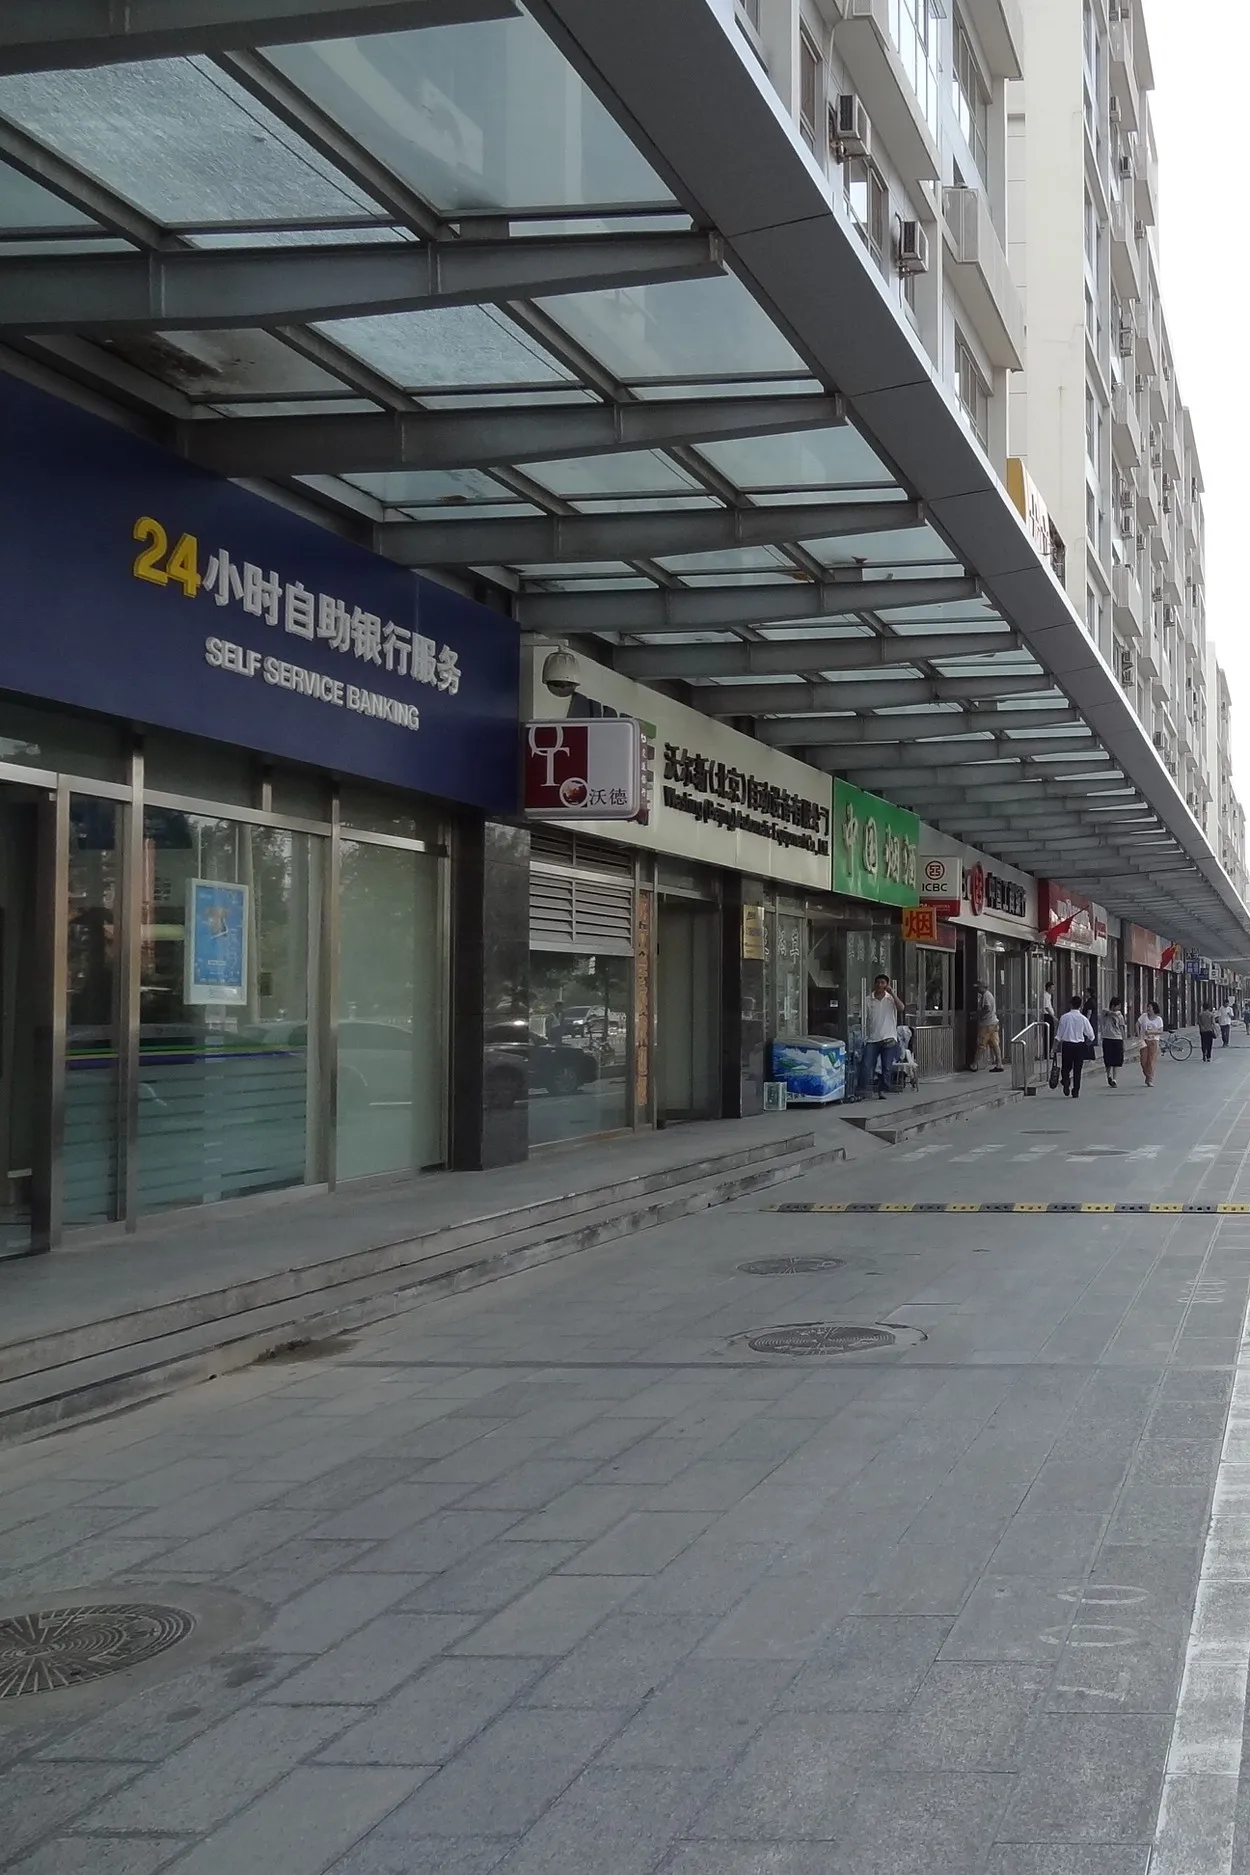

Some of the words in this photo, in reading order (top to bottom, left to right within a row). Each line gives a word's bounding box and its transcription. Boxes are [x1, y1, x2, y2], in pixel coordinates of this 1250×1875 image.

[133, 516, 462, 695] 24小时自助银行服务
[204, 637, 261, 678] SELF
[263, 654, 345, 706] SERVICE
[346, 684, 420, 731] BANKING
[589, 788, 628, 806] 沃德
[921, 883, 948, 892] ICBC
[905, 910, 934, 938] 烟
